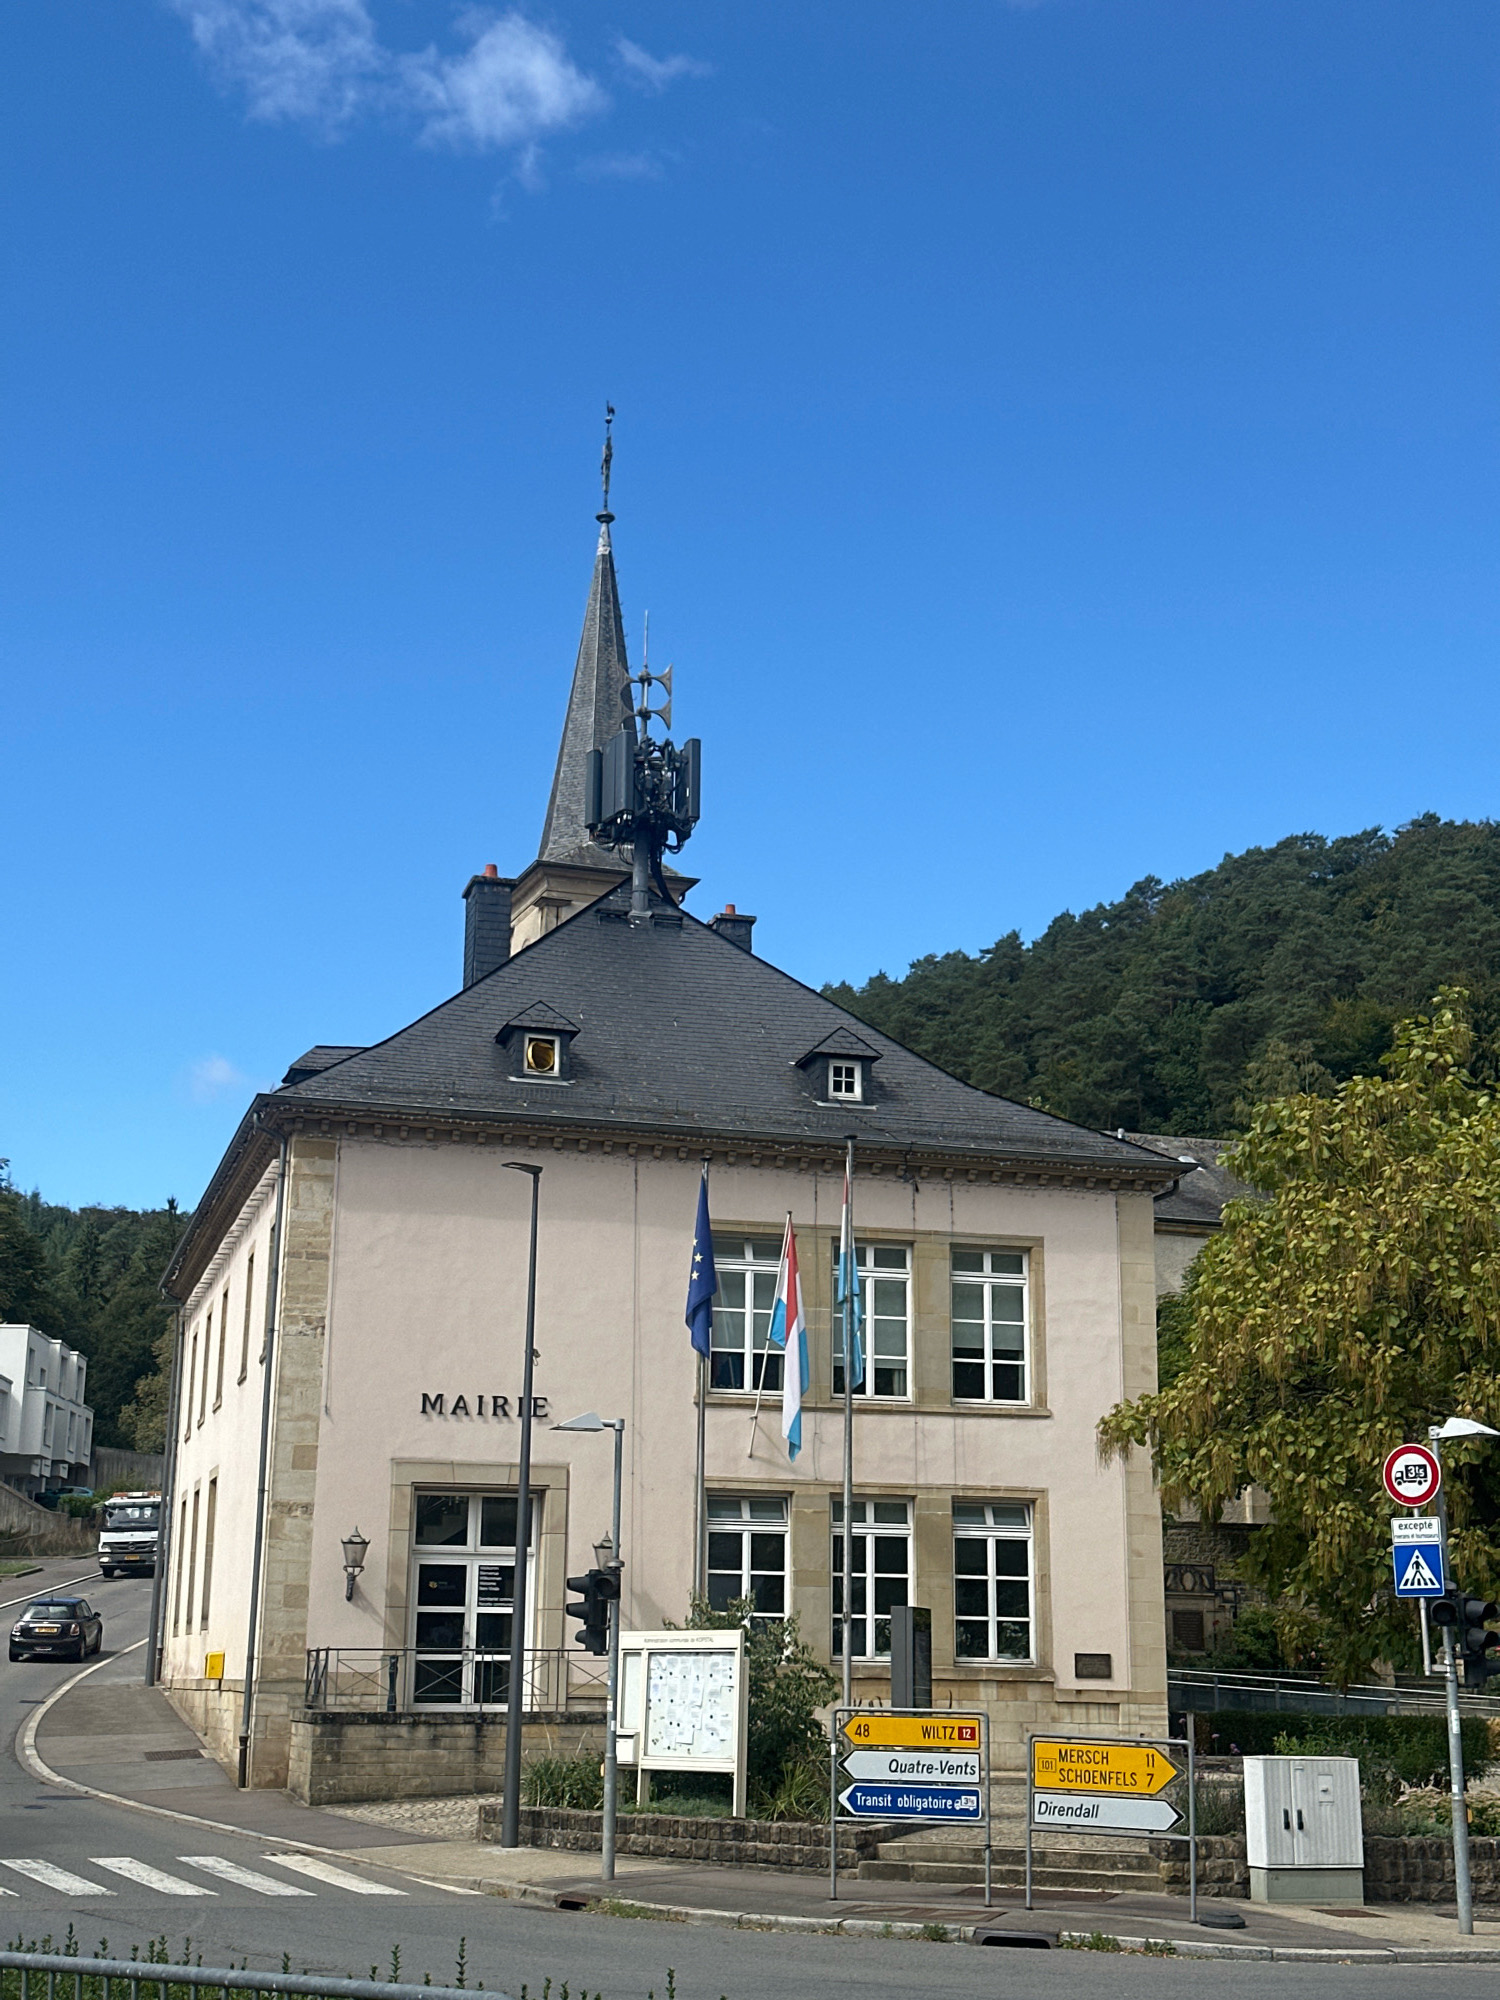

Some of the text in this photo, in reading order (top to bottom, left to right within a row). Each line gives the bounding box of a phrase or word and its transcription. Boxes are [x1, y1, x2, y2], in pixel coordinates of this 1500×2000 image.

[420, 1393, 549, 1418] MAIRIE
[1398, 1520, 1433, 1532] excepté
[855, 1723, 870, 1738] 48
[921, 1725, 956, 1741] WILTZ
[962, 1728, 972, 1739] 12
[888, 1758, 977, 1776] Quatre-Vents
[1041, 1760, 1053, 1771] 101
[1058, 1748, 1155, 1768] MERSCH 11
[1058, 1768, 1154, 1788] SCHOENFELS 7
[855, 1792, 953, 1812] Transit obligatoire
[1037, 1800, 1100, 1819] Direndall
